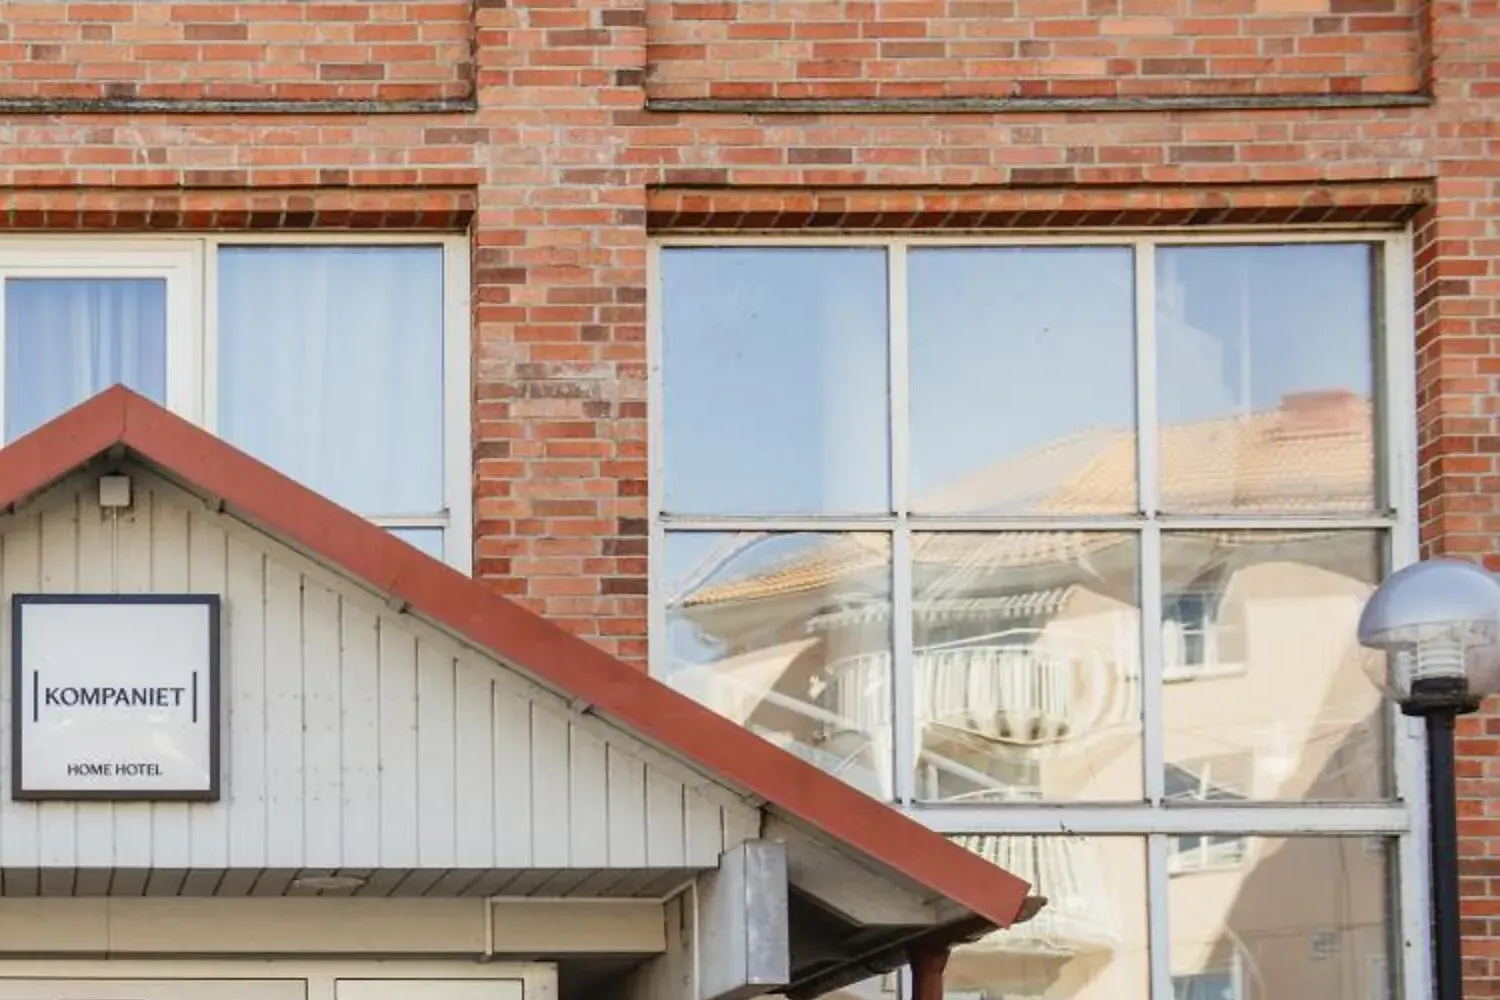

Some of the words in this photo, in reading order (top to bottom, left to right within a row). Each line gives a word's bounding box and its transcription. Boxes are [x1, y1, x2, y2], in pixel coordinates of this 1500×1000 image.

[45, 687, 185, 706] KOMPANIET
[67, 764, 112, 776] HOME
[115, 764, 162, 776] HOTEL
